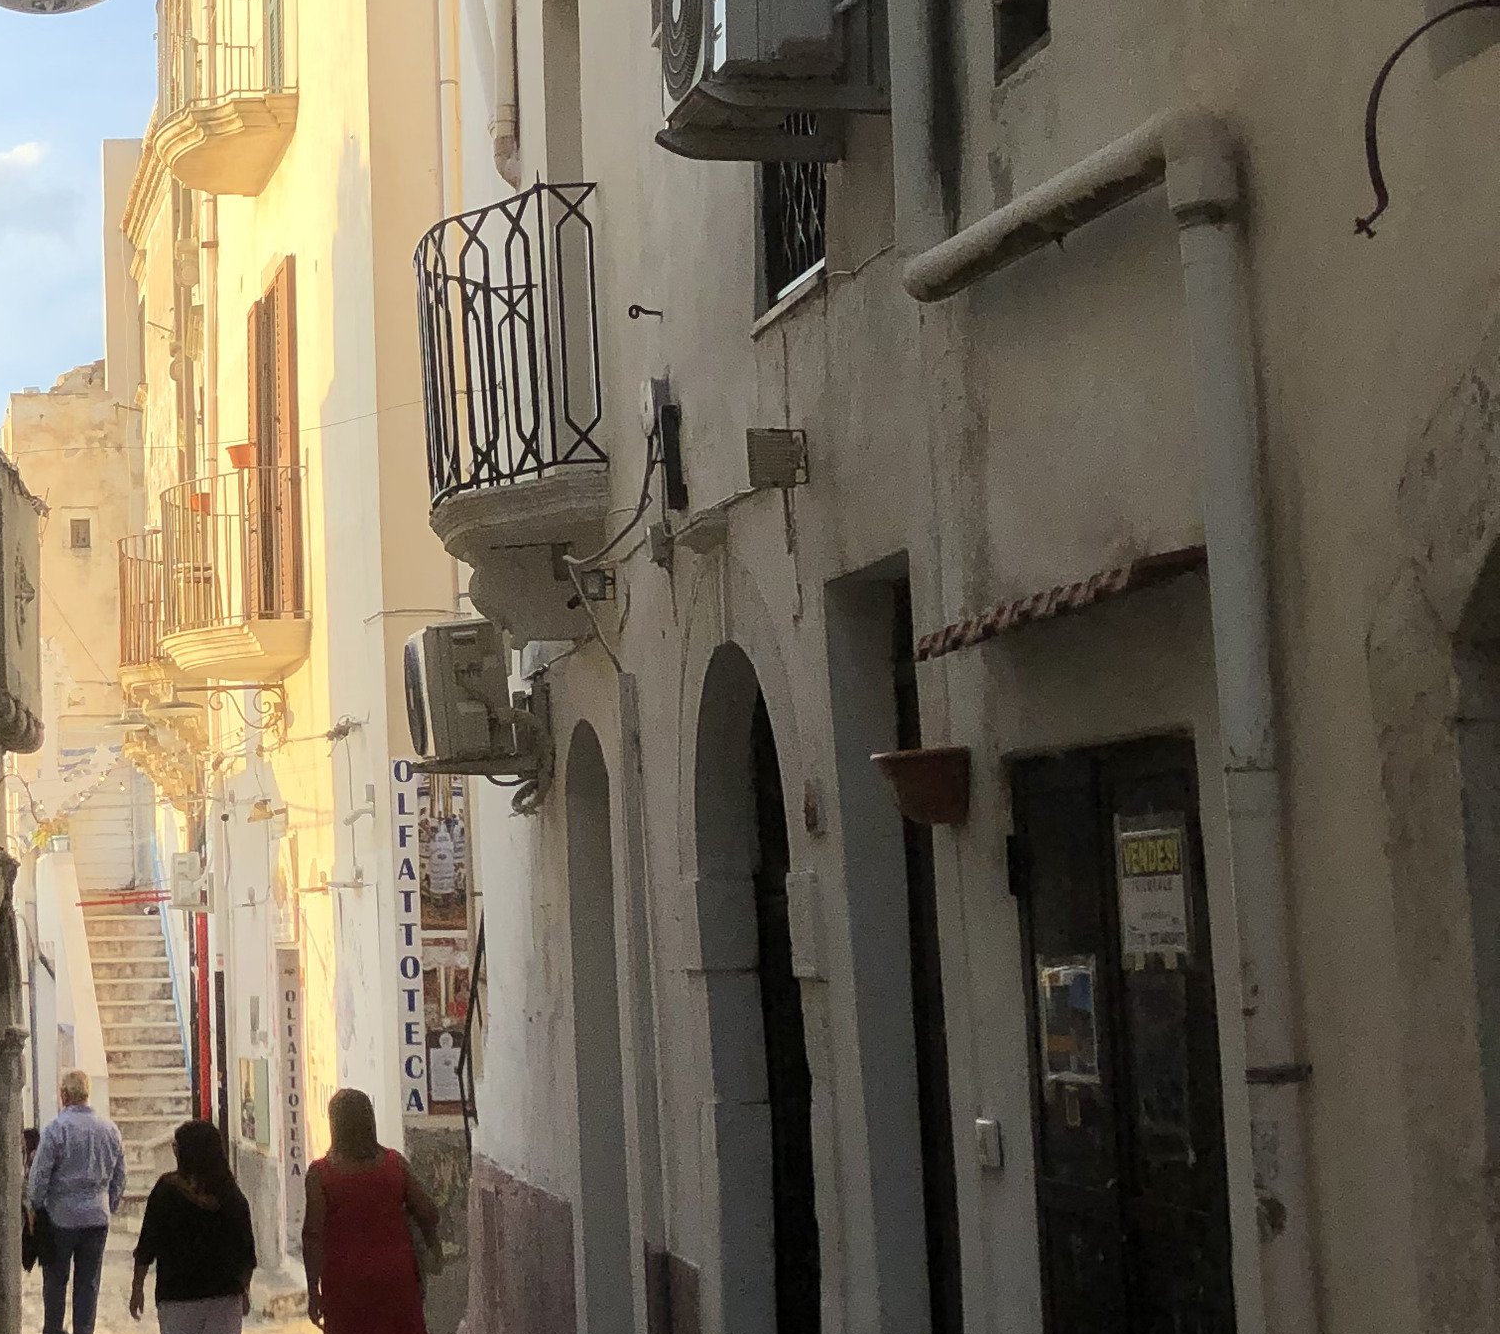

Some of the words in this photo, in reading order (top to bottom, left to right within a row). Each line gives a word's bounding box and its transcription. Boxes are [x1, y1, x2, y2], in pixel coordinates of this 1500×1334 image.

[392, 759, 425, 1112] OLFATTOTECA
[1124, 839, 1179, 873] VENDESI
[284, 989, 302, 1176] OLFATTOTECA
